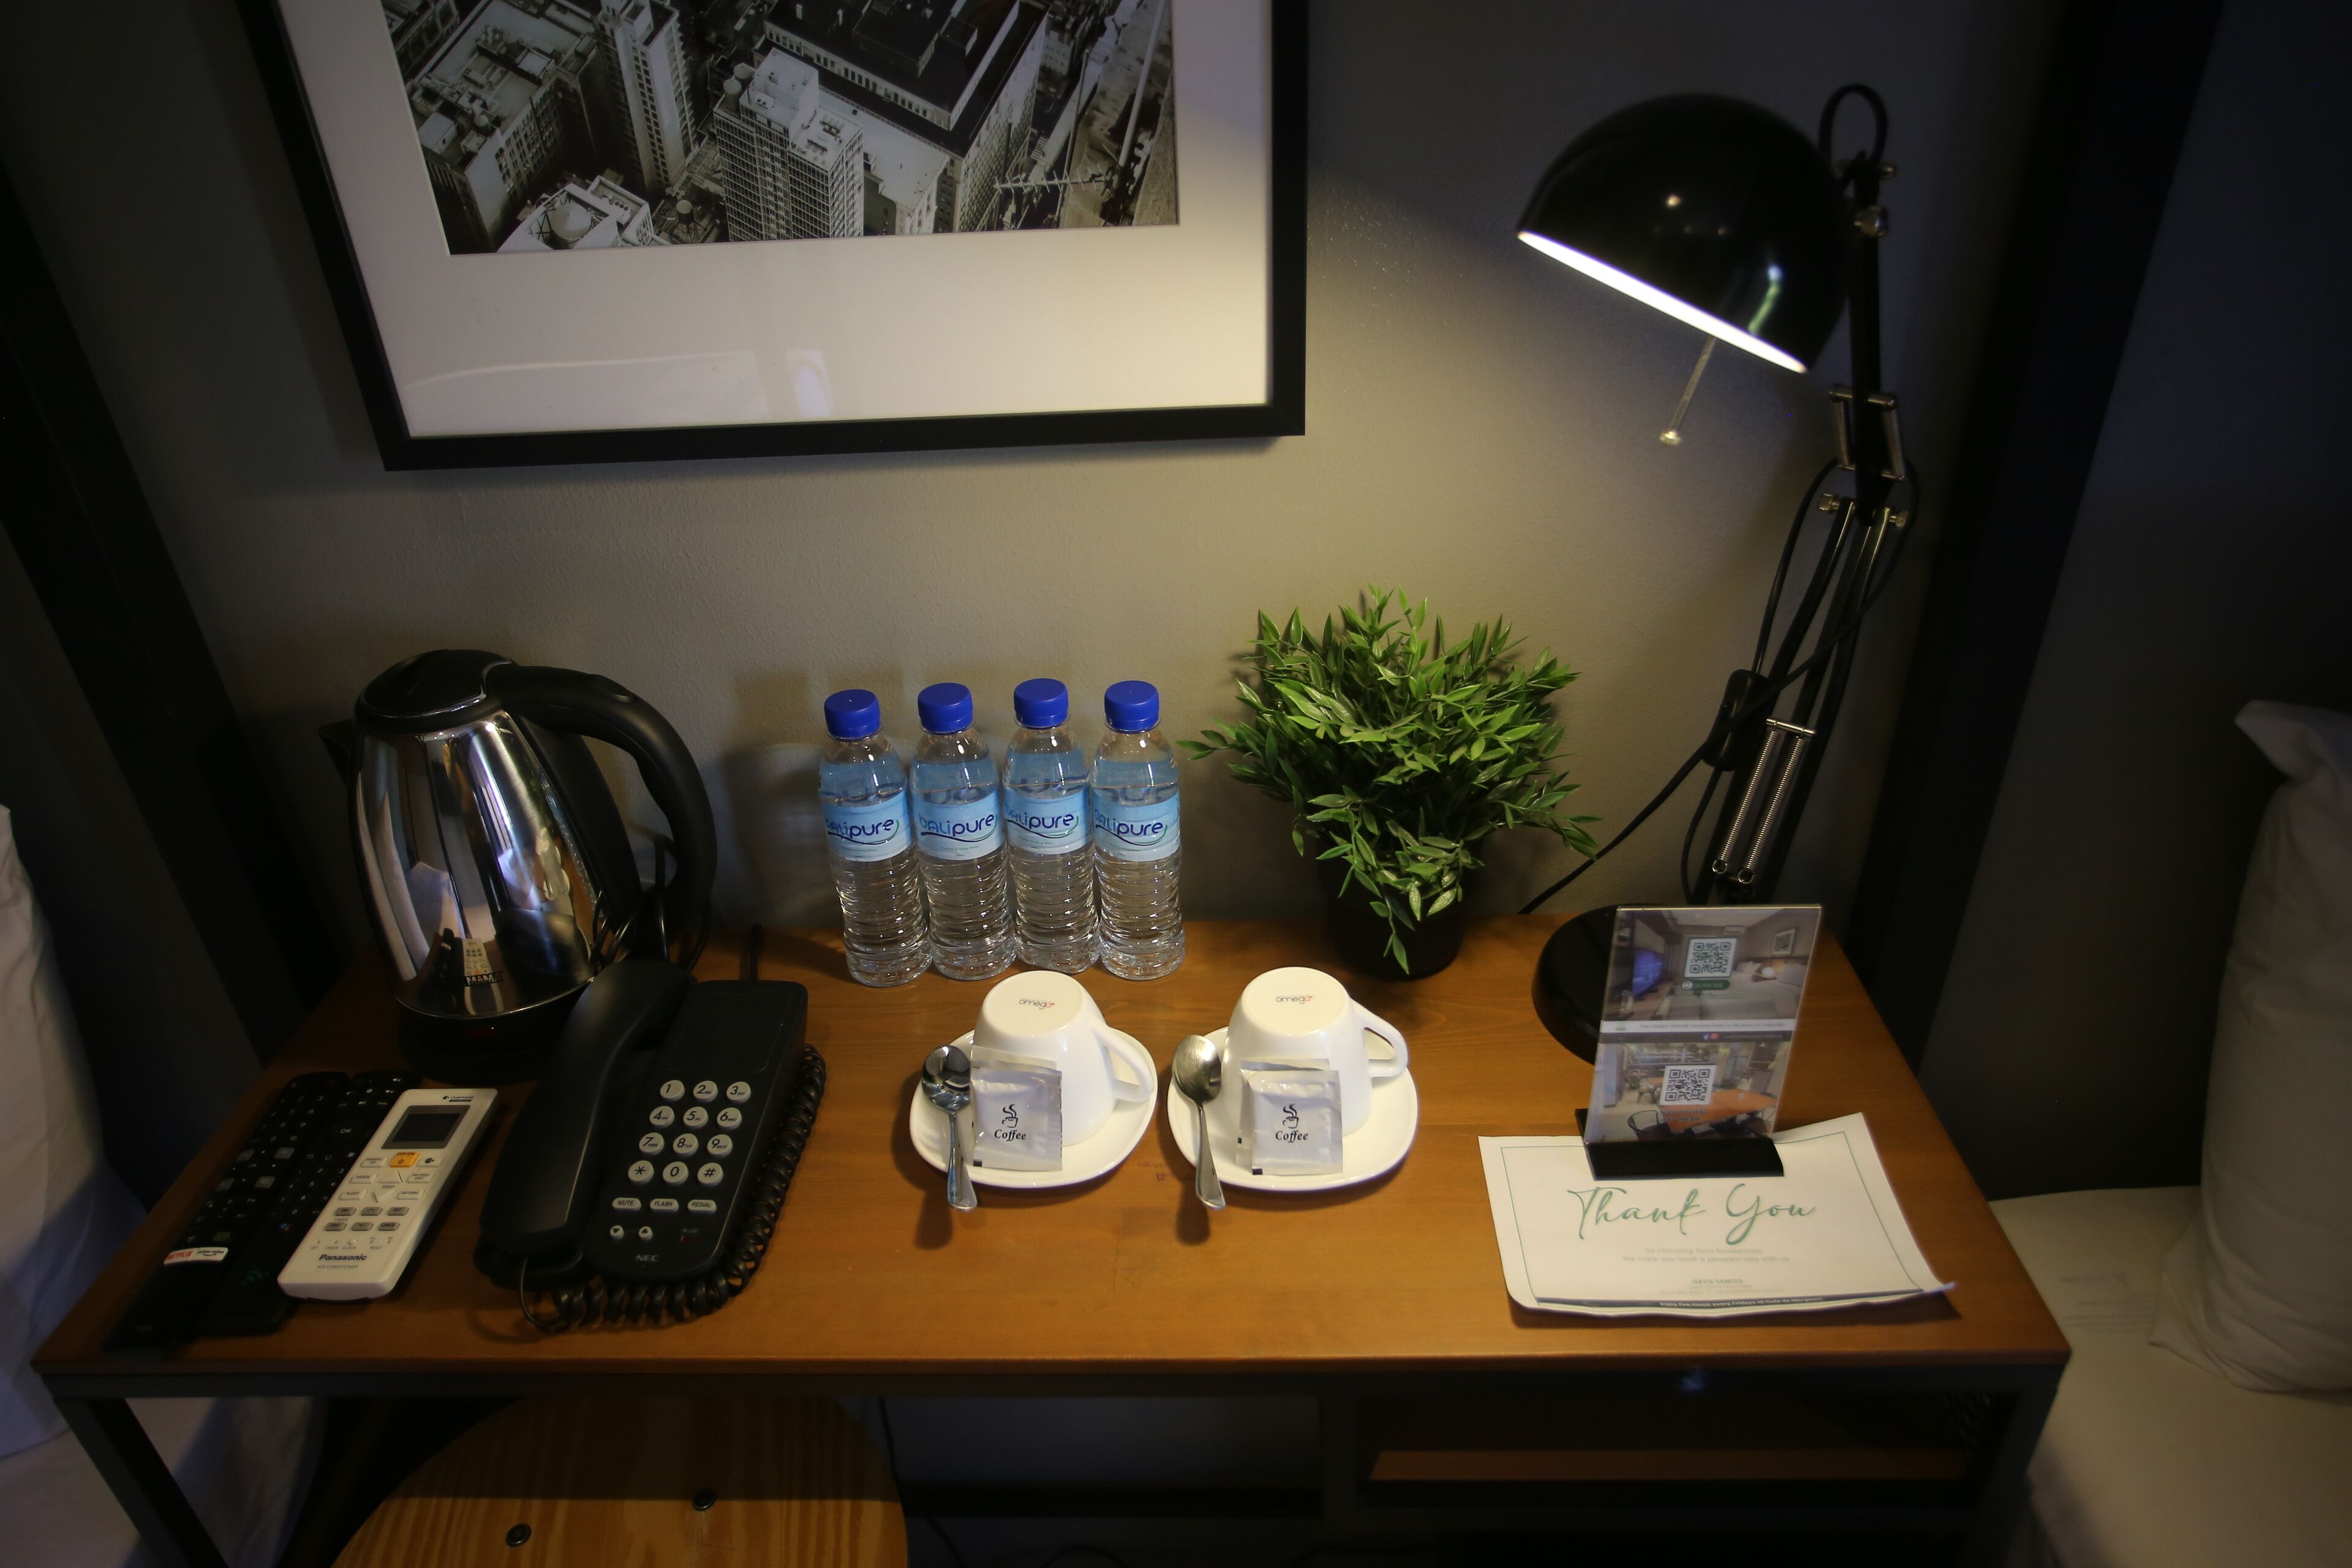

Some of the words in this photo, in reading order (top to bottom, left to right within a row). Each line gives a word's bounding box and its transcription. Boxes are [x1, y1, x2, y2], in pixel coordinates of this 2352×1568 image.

[665, 1084, 671, 1093] 1
[696, 1085, 706, 1094] 2
[729, 1086, 738, 1095] 3
[653, 1110, 662, 1120] 4
[687, 1111, 696, 1120] 5
[720, 1112, 728, 1121] 6
[994, 1129, 1027, 1142] Coffee
[1275, 1130, 1308, 1143] Coffee
[643, 1137, 654, 1147] 7
[677, 1137, 685, 1148] 8
[711, 1139, 720, 1148] 9
[670, 1166, 679, 1177] 0
[1567, 1186, 1706, 1240] Thank
[1725, 1183, 1816, 1245] You
